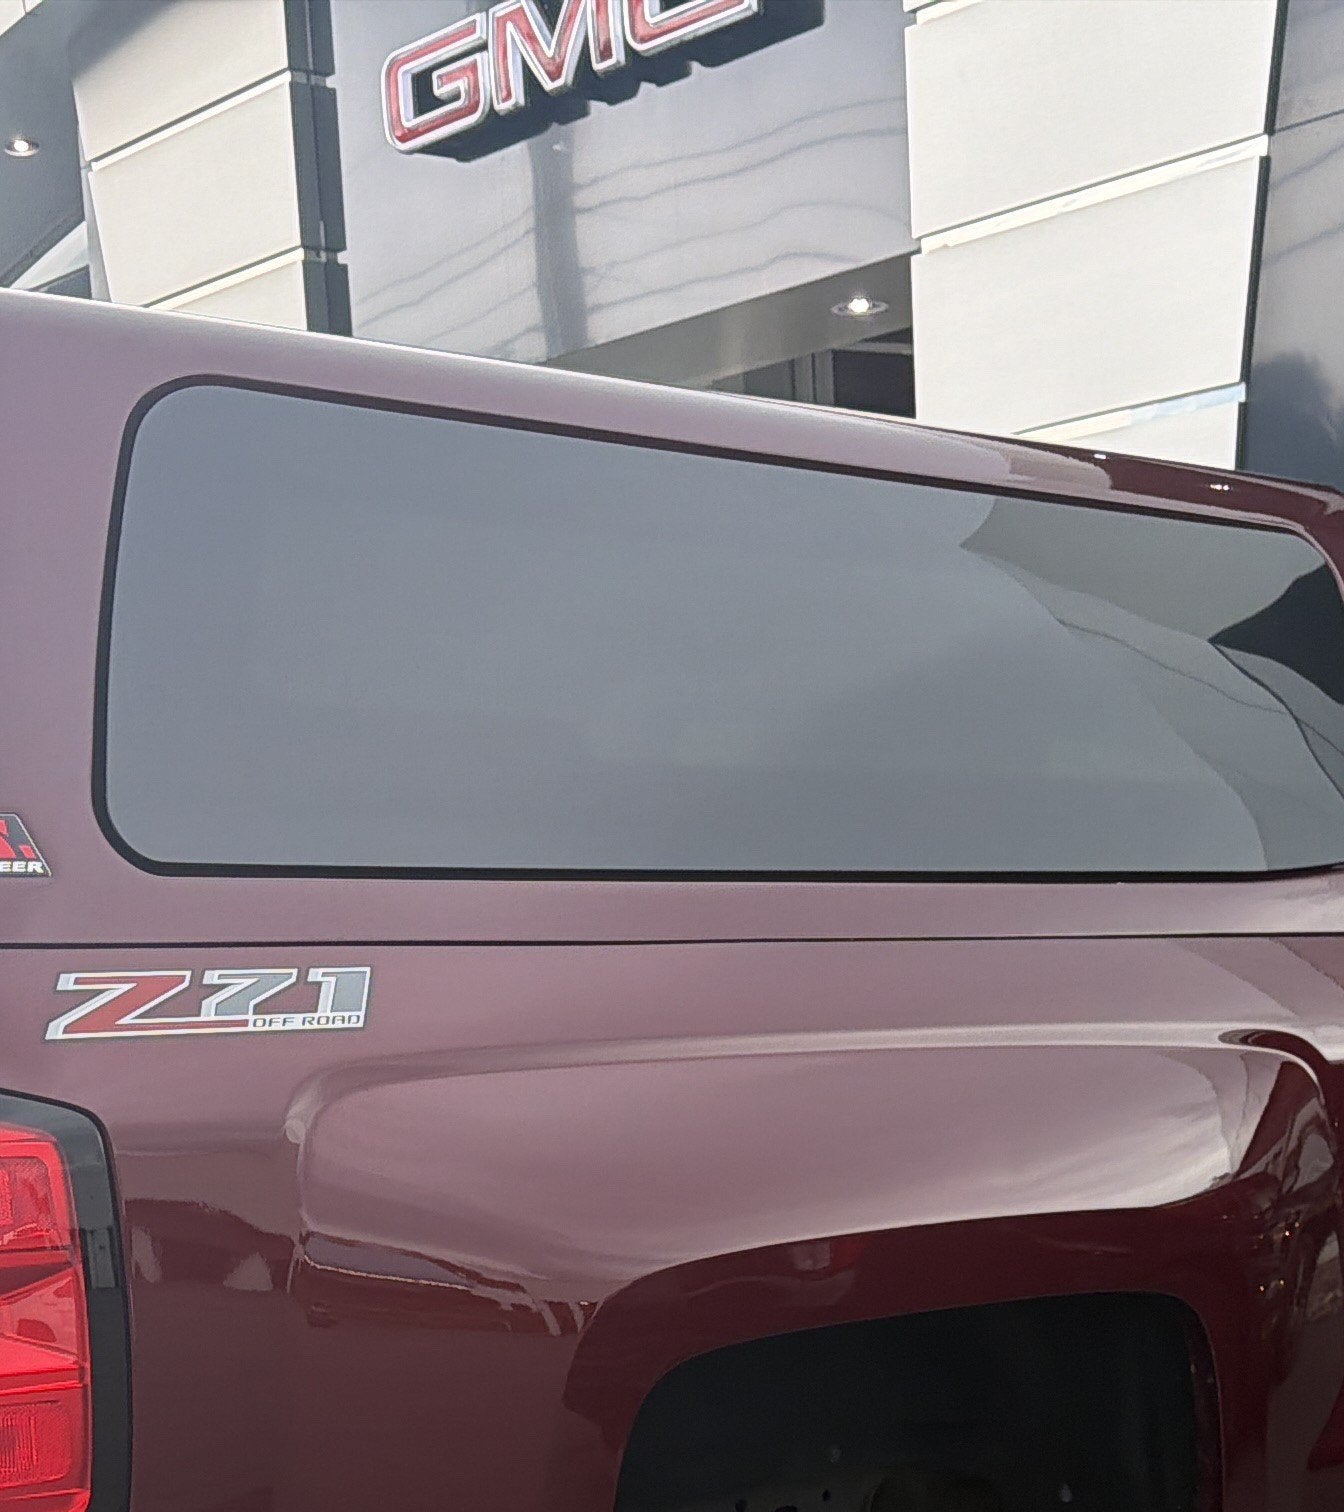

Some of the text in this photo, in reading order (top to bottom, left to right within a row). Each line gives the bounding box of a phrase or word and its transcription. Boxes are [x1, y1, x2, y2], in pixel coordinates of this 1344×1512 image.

[44, 966, 371, 1040] Z71
[252, 1014, 361, 1029] OFF ROAD
